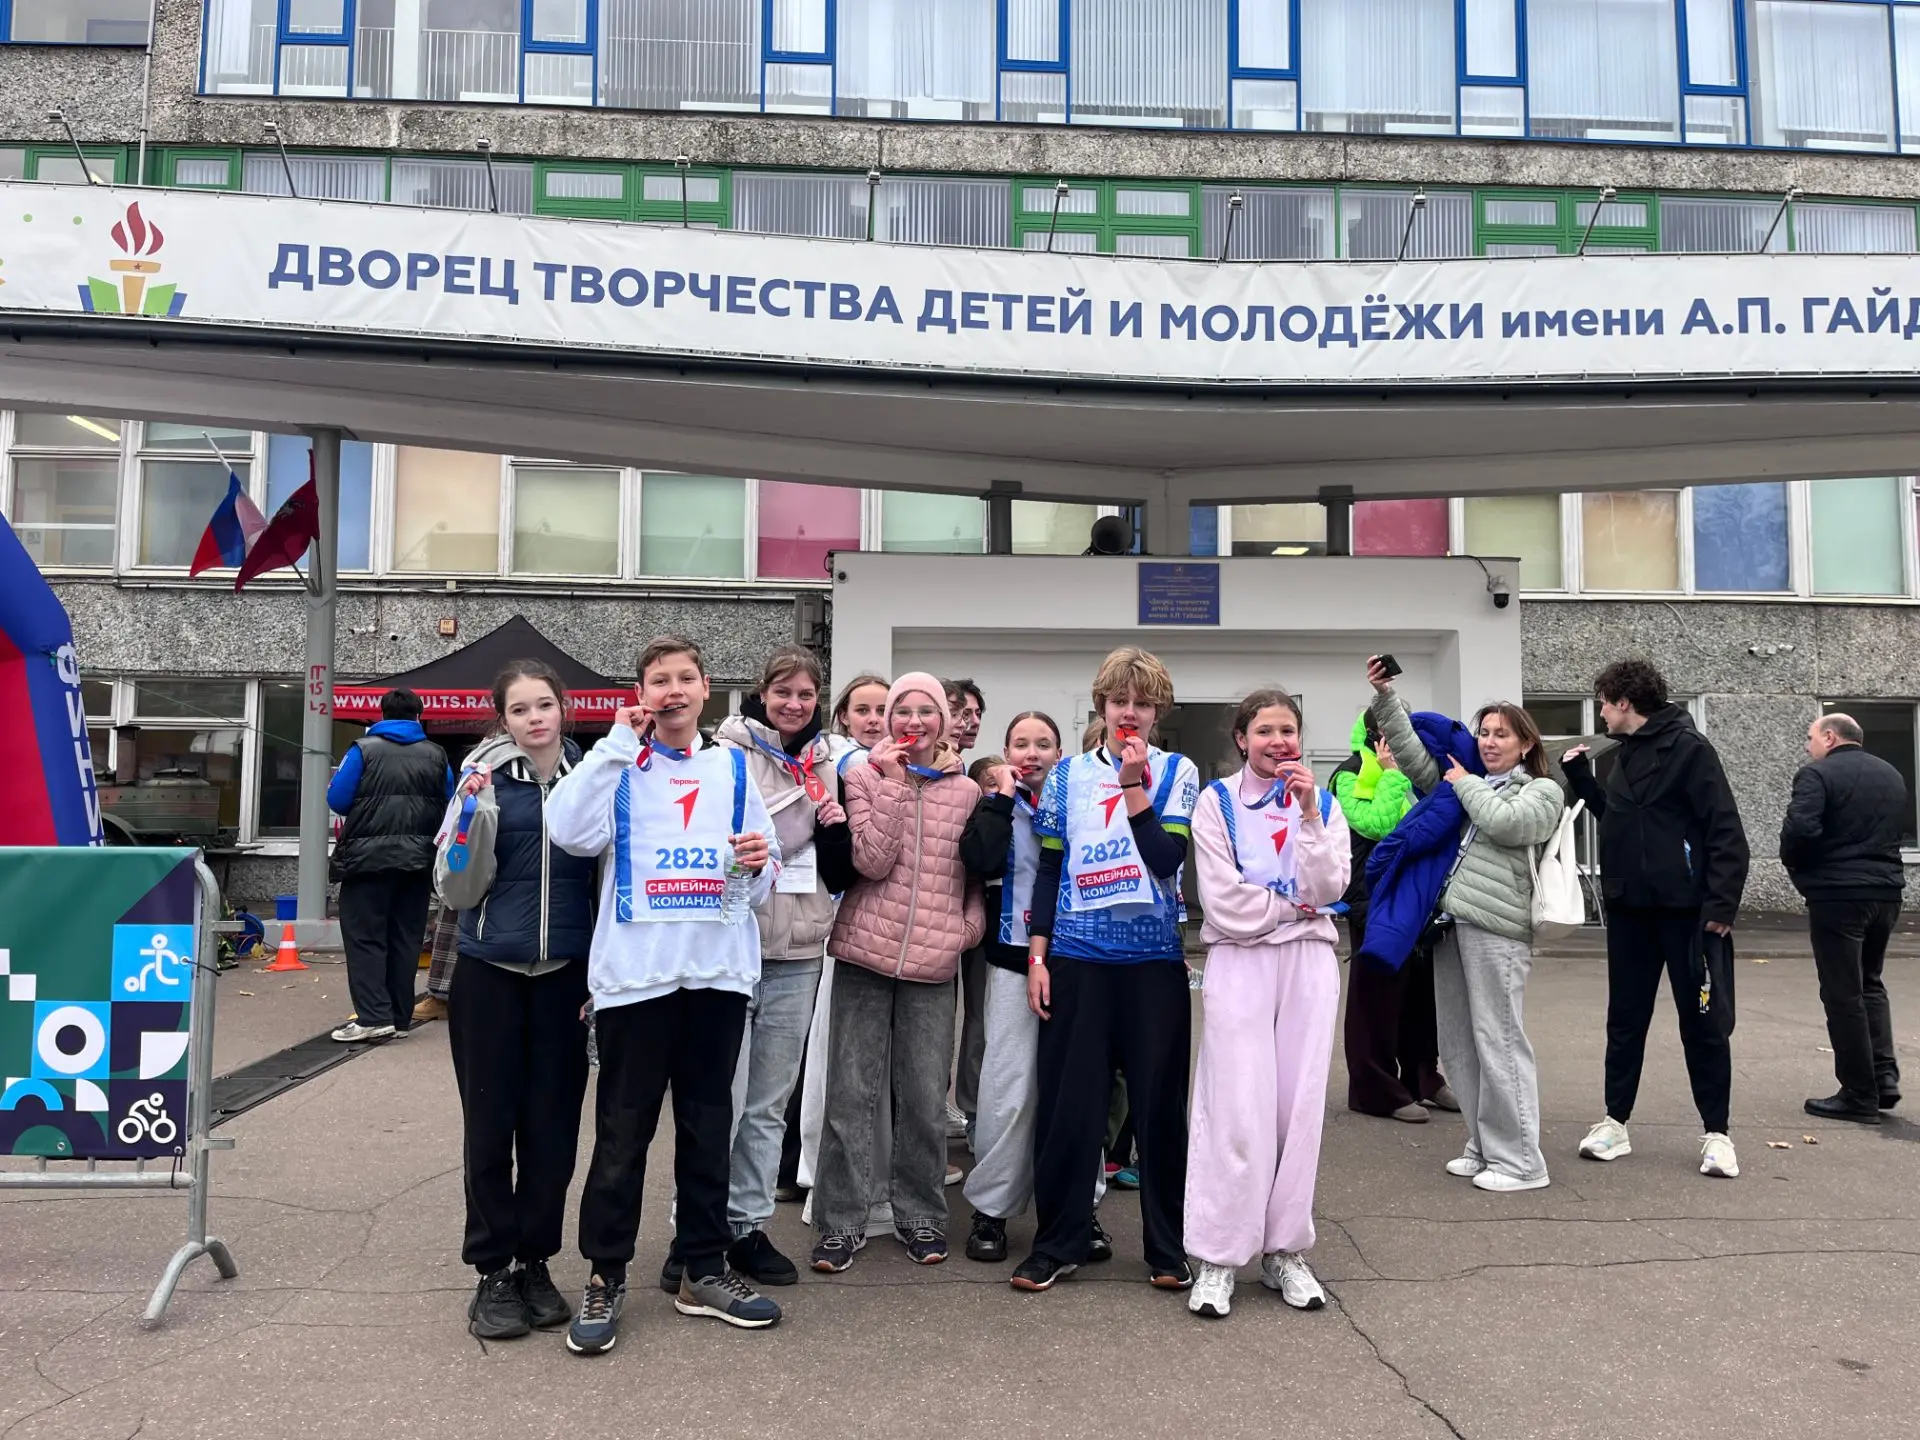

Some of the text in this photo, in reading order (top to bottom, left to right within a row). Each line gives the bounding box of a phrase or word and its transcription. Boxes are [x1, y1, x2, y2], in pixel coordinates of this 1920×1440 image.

[268, 243, 519, 304] ДВОРЕЦ
[534, 262, 903, 323] ТВОРЧЕСТВА
[917, 287, 1092, 335] ДЕТЕЙ
[1110, 300, 1142, 338] И
[1160, 294, 1483, 348] МОЛОДЁЖИ
[1502, 308, 1664, 338] имени
[1682, 297, 1786, 334] А.П.
[309, 681, 323, 696] 15
[56, 642, 105, 847] ФИНИ
[655, 847, 719, 870] 2823
[1081, 836, 1132, 865] 2822
[647, 879, 725, 893] СЕМЕЙНАЯ
[1077, 865, 1139, 887] СЕМЕЙНАЯ
[1081, 880, 1137, 899] КОМАНДА
[651, 895, 722, 909] КОМАНДА
